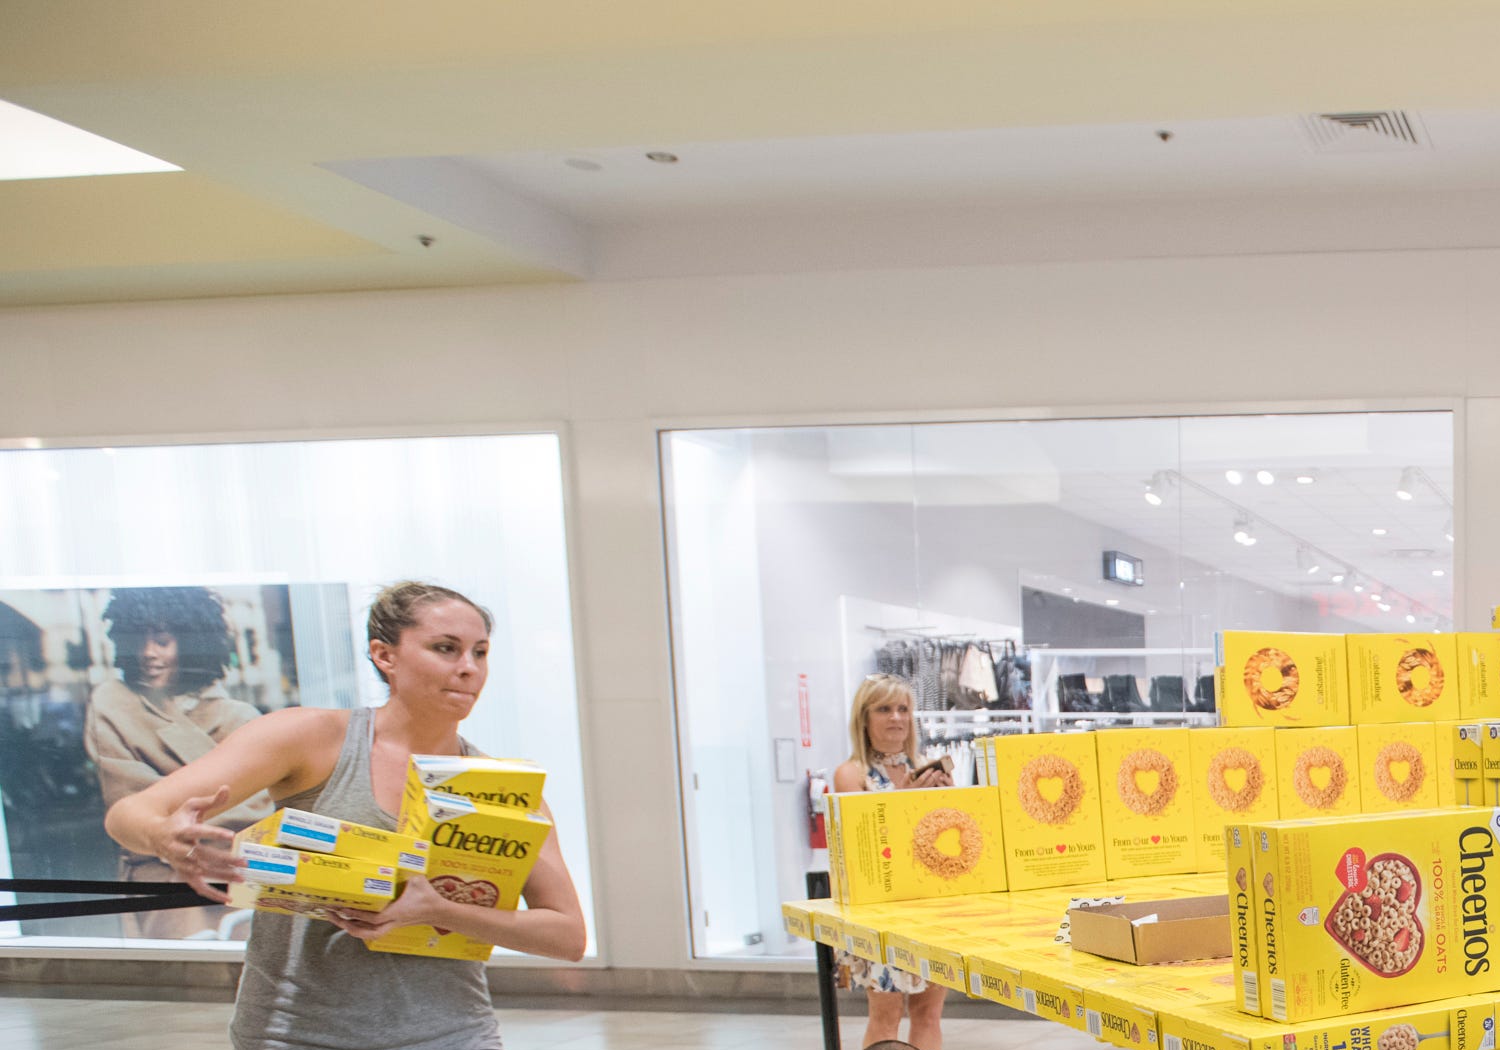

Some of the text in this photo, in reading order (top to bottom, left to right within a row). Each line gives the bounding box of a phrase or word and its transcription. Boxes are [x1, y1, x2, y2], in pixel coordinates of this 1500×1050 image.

[1454, 758, 1477, 770] Cheerios
[877, 803, 886, 825] From
[432, 821, 530, 860] Cheerios
[1015, 848, 1035, 858] From
[1068, 844, 1077, 852] to
[1077, 843, 1096, 852] Yours
[1113, 838, 1132, 847] From
[1162, 834, 1170, 843] to
[1170, 834, 1188, 843] Yours
[1203, 834, 1220, 842] From
[1459, 826, 1496, 976] Cheerios
[1432, 858, 1447, 974] 100% OATS
[1236, 892, 1249, 968] Cheerios
[1263, 898, 1278, 975] Cheerios
[929, 959, 949, 980] Cheerios
[981, 974, 1004, 996] Cheerios
[1340, 958, 1350, 1010] Gluten Free
[1035, 990, 1062, 1015] Cheerios
[1101, 1011, 1131, 1040] Cheerios
[1456, 1009, 1467, 1050] Cheerios
